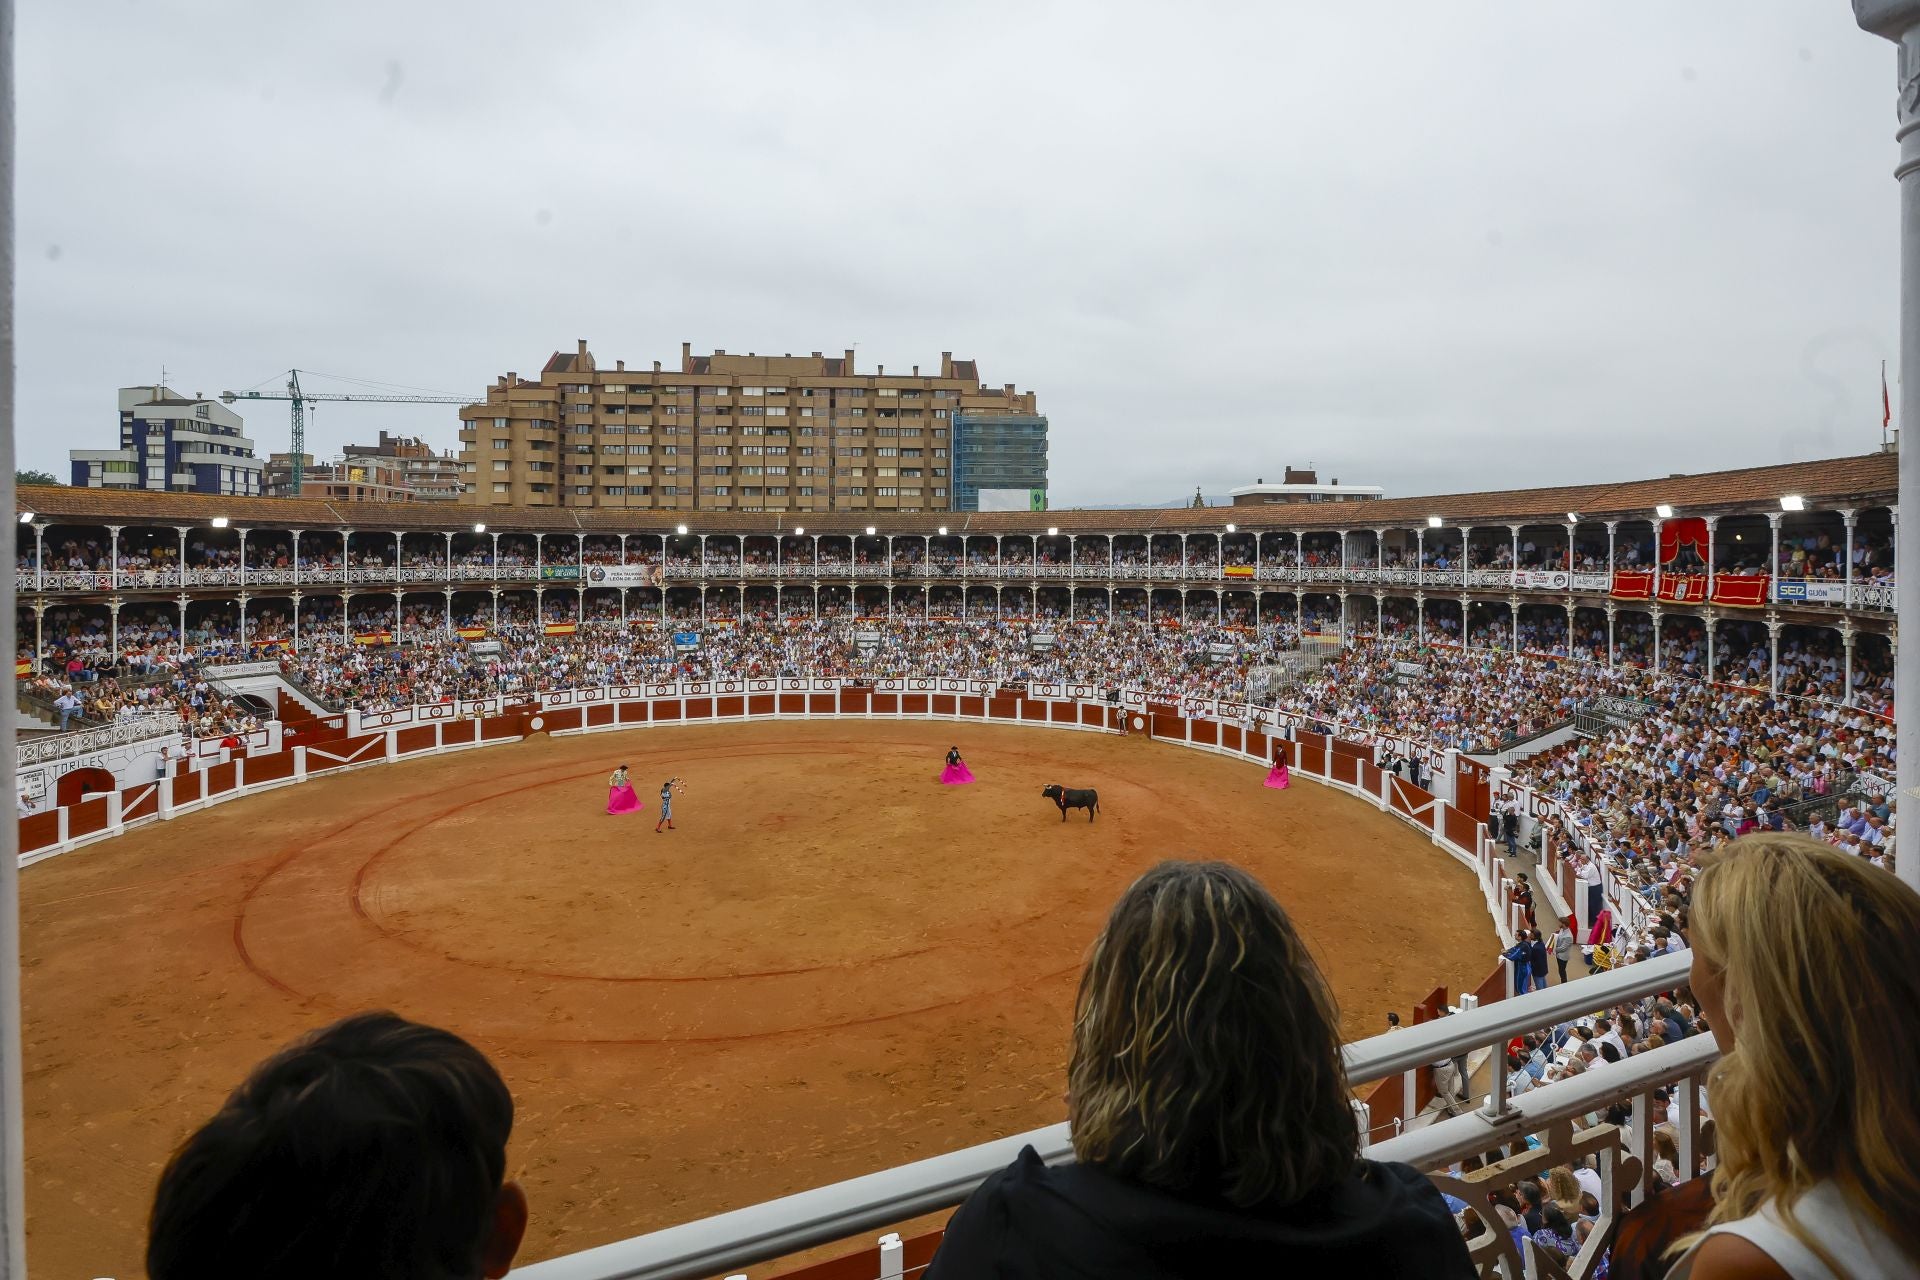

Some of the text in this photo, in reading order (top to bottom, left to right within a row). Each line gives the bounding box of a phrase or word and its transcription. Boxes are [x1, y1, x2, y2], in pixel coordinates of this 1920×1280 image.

[1780, 585, 1805, 596] SER
[1808, 588, 1828, 597] GIJÓN
[51, 755, 104, 778] TORILES
